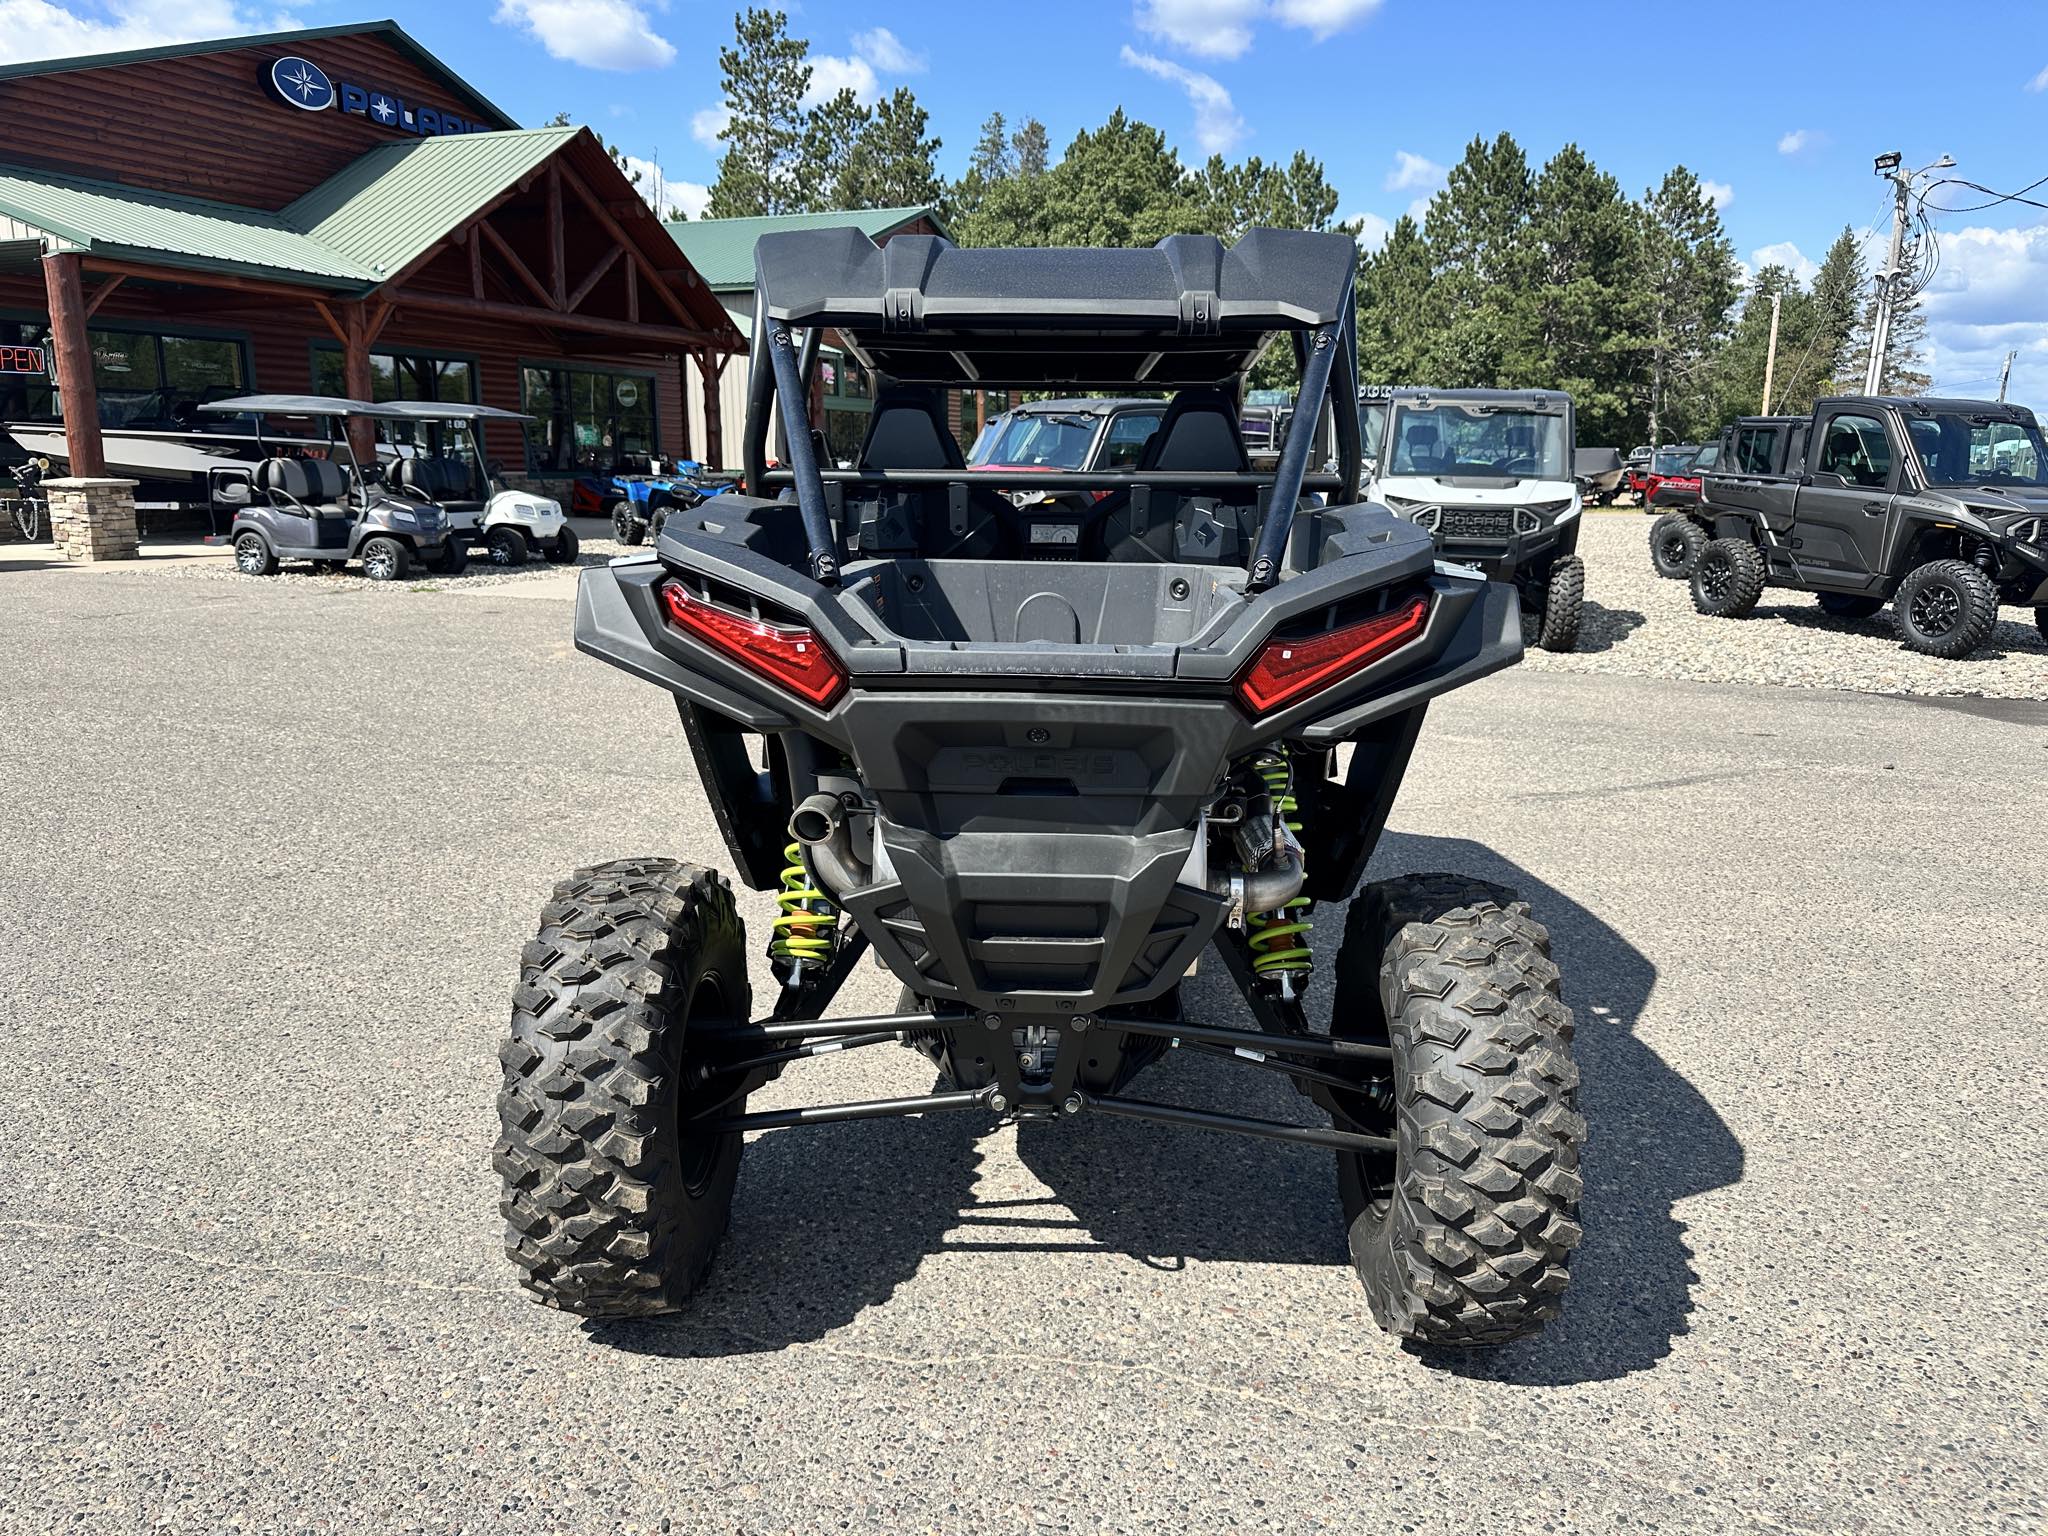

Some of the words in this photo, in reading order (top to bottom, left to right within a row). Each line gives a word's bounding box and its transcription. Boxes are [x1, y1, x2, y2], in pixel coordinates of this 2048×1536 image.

[0, 347, 42, 372] PEN
[1713, 482, 1760, 494] RANGER
[1444, 515, 1509, 527] POLARIS
[963, 752, 1117, 775] POLARIS
